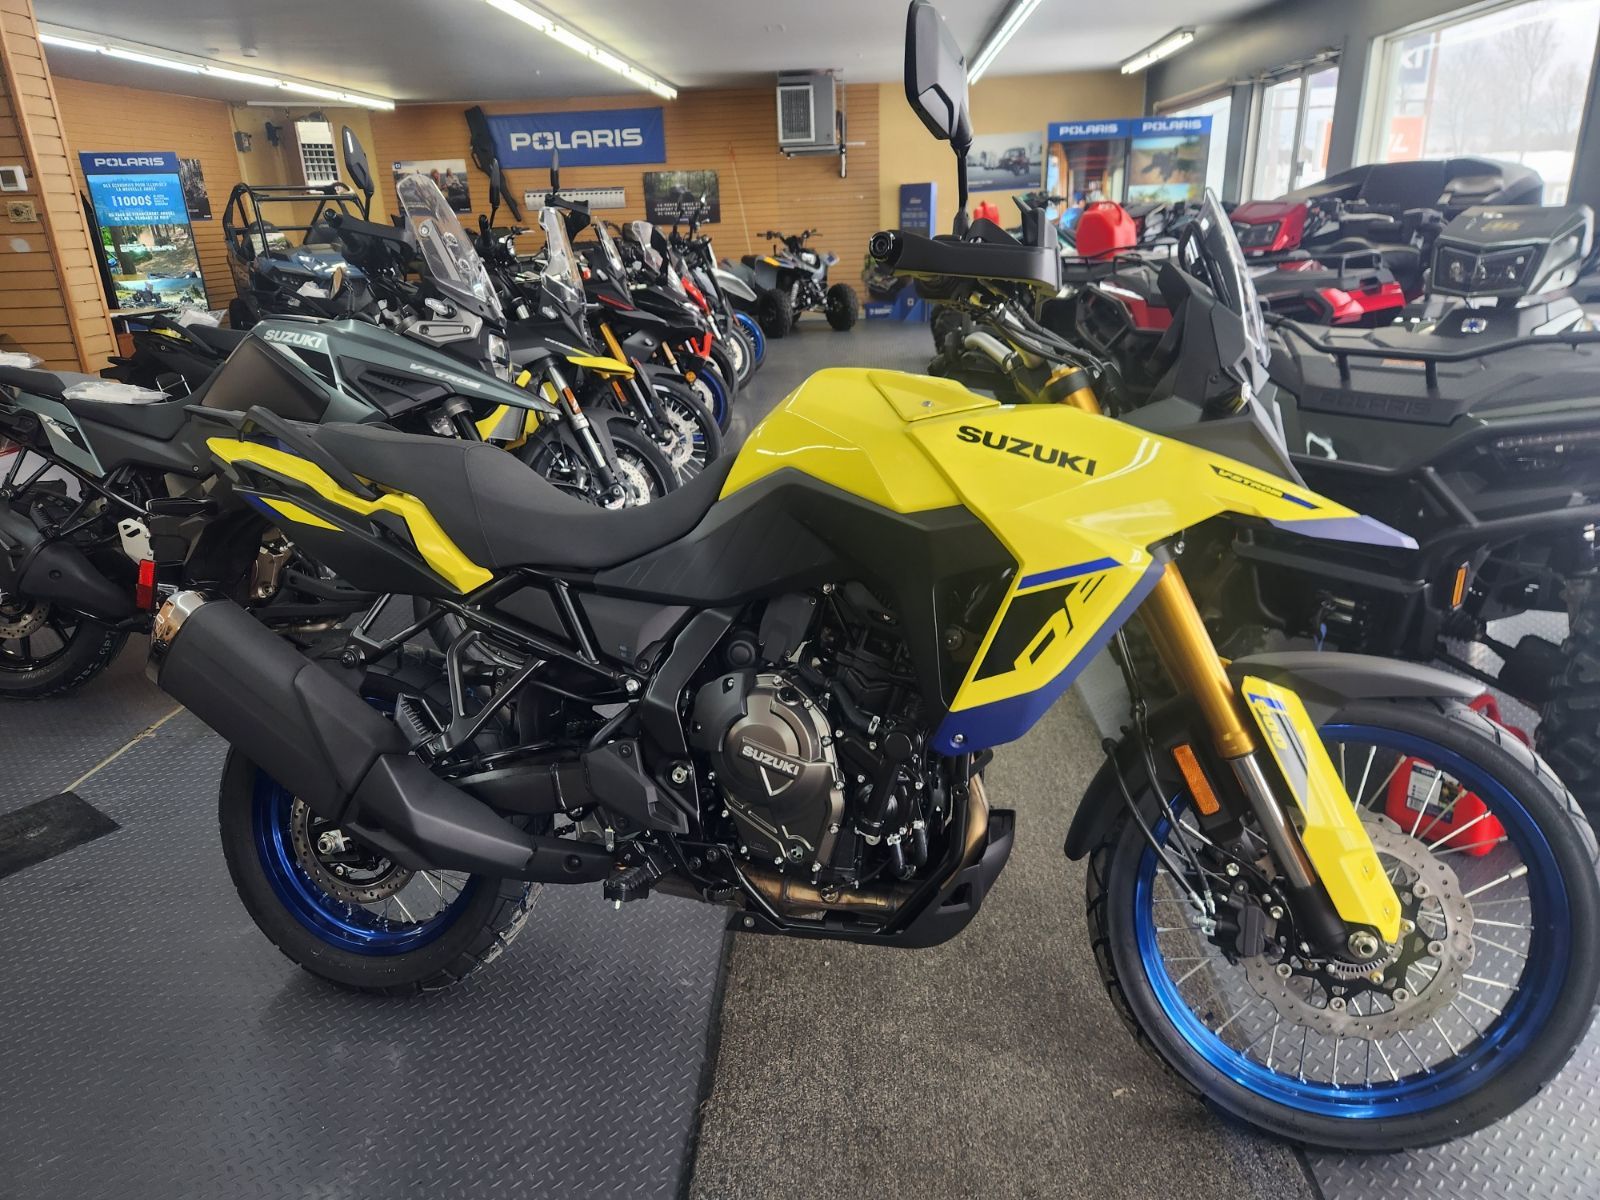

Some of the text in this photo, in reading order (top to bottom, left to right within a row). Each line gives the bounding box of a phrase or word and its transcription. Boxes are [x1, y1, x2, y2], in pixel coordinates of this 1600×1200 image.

[1059, 123, 1118, 136] POLARIS
[1142, 119, 1202, 132] POLARIS
[510, 128, 643, 152] POLARIS
[94, 157, 165, 167] POLARIS
[117, 195, 152, 206] 1000$
[263, 329, 323, 350] SUZUKI
[956, 425, 1097, 476] SUZUKI
[742, 745, 800, 775] SUZUKI
